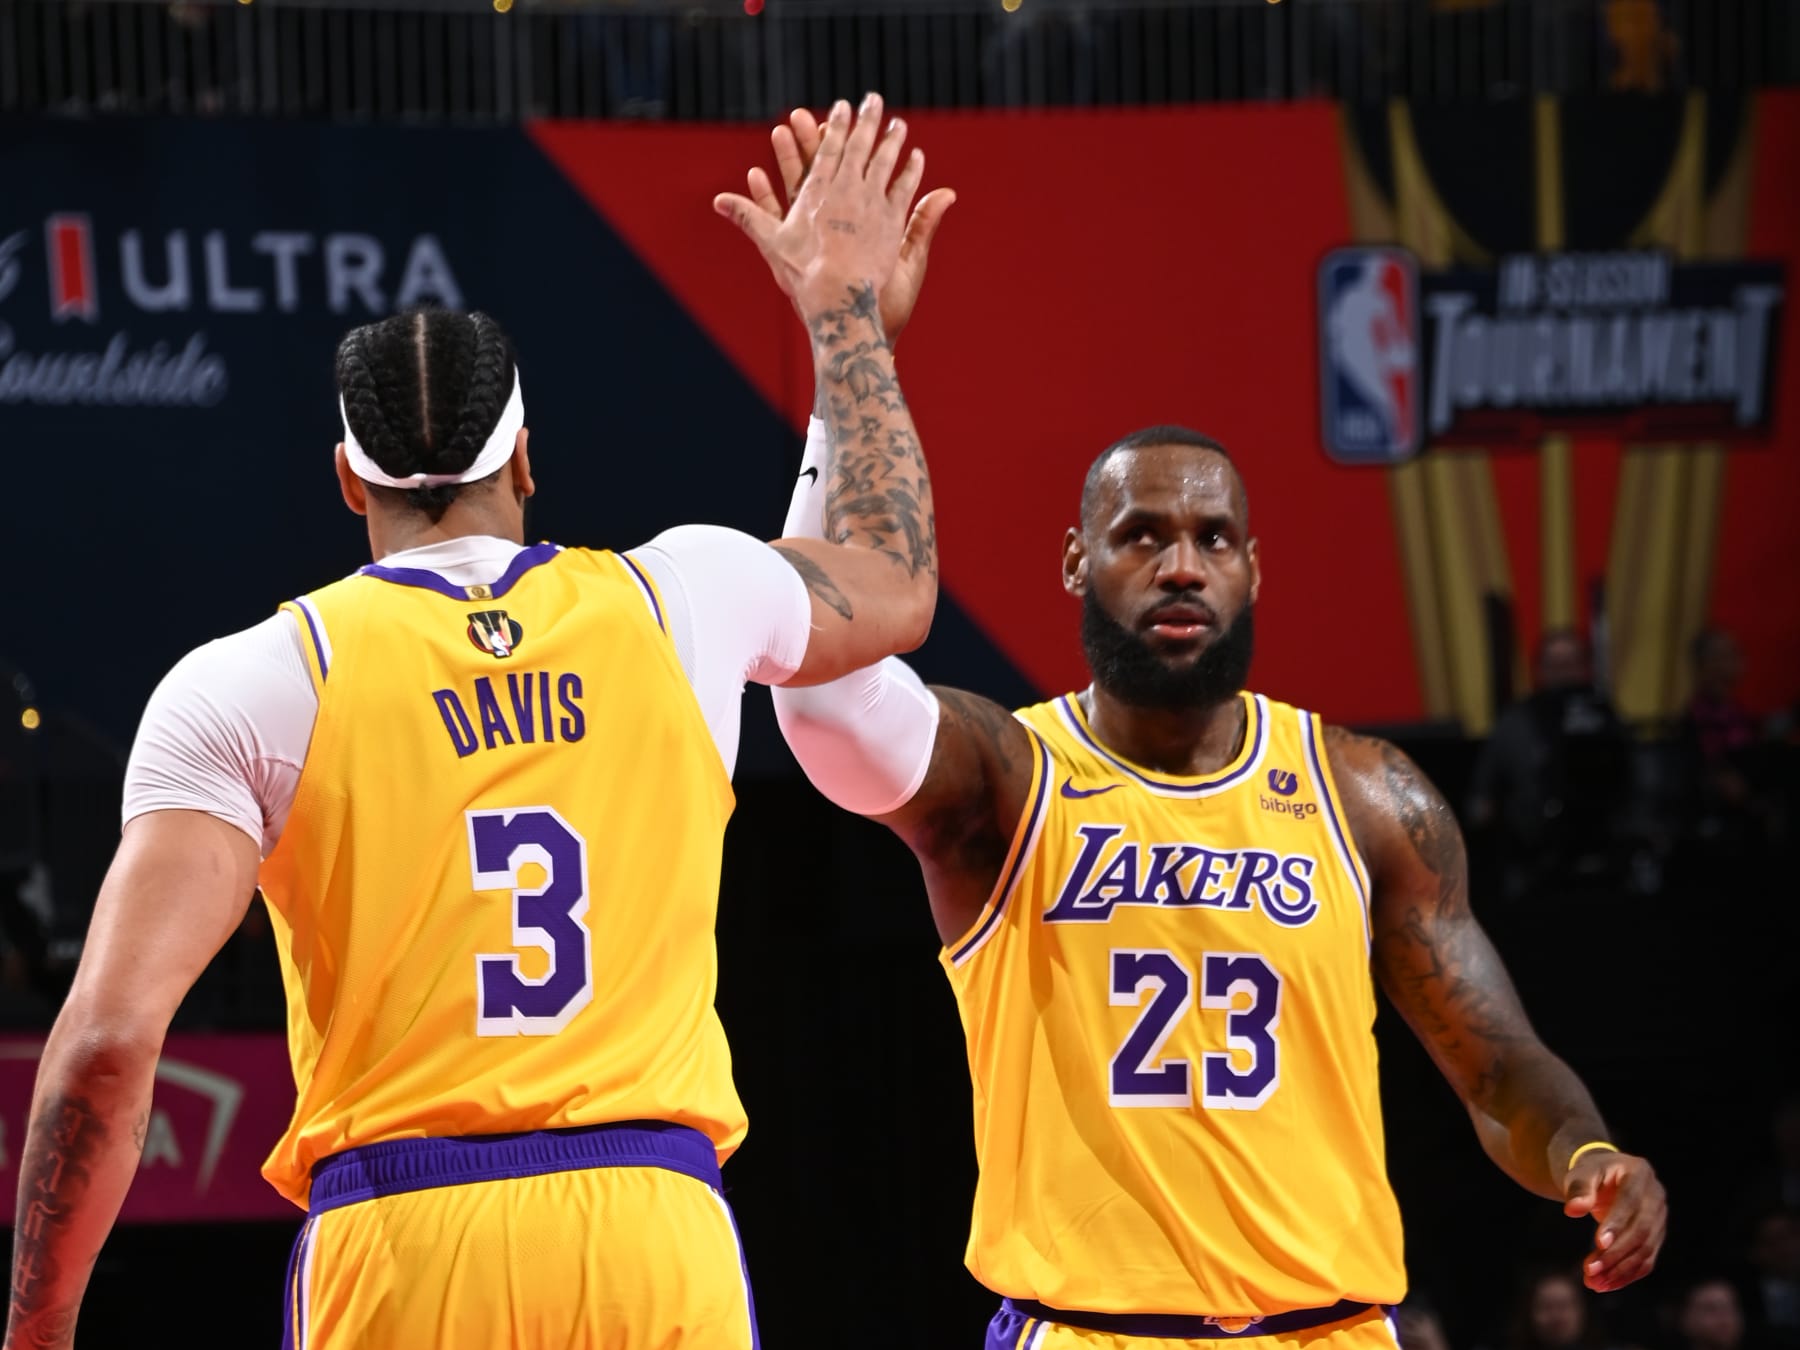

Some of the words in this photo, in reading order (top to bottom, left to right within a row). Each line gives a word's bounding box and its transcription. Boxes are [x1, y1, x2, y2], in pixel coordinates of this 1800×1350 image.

[120, 228, 463, 315] ULTRA
[0, 318, 228, 406] ourtside
[1426, 285, 1784, 434] TOURNAMENT
[432, 671, 586, 759] DAVIS
[1259, 794, 1318, 820] bibigo
[465, 805, 594, 1037] 3
[1042, 822, 1320, 929] LAKERS
[1108, 948, 1284, 1111] 23
